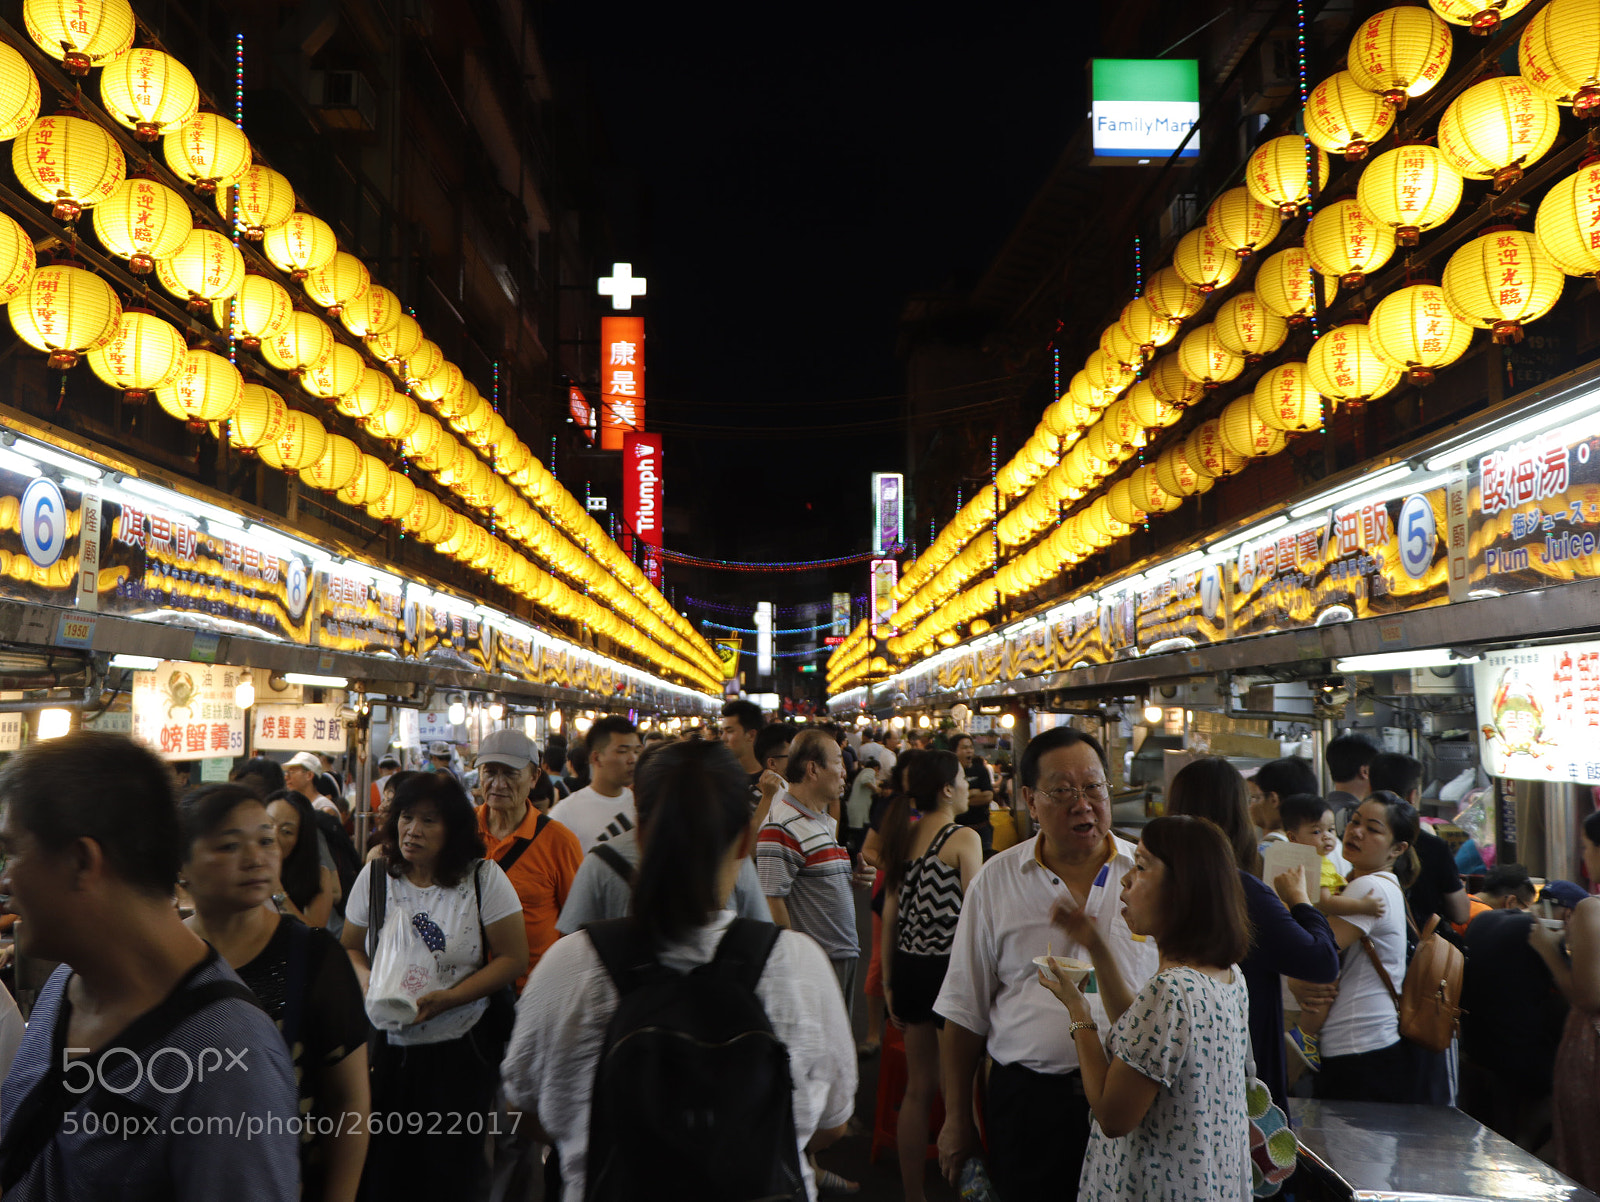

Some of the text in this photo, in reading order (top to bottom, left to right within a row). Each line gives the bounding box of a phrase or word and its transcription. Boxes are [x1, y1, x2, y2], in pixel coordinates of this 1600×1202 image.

[70, 0, 90, 34] 十組
[36, 118, 61, 185] 歡迎光臨
[1098, 117, 1196, 135] FamilyMart
[1400, 158, 1425, 212] 開漳聖王
[134, 183, 156, 243] 歡迎光臨
[1496, 236, 1523, 306] 歡迎光臨
[36, 281, 59, 335] 開漳聖王
[1420, 290, 1444, 354] 歡迎光臨
[277, 331, 294, 360] 光臨
[1330, 331, 1355, 388] 歡迎光臨
[609, 340, 637, 427] 康是美
[1278, 368, 1298, 421] 歡迎光臨
[635, 458, 660, 535] Triumph
[33, 496, 54, 552] 6
[119, 503, 198, 564] 旗魚飯
[1407, 508, 1427, 565] 5
[1485, 530, 1596, 577] Plum Juice
[291, 569, 301, 606] 8
[67, 624, 87, 638] 1950
[160, 722, 231, 753] 螃蟹羹
[230, 731, 243, 749] 55
[261, 715, 342, 742] 螃蟹羹 油飯
